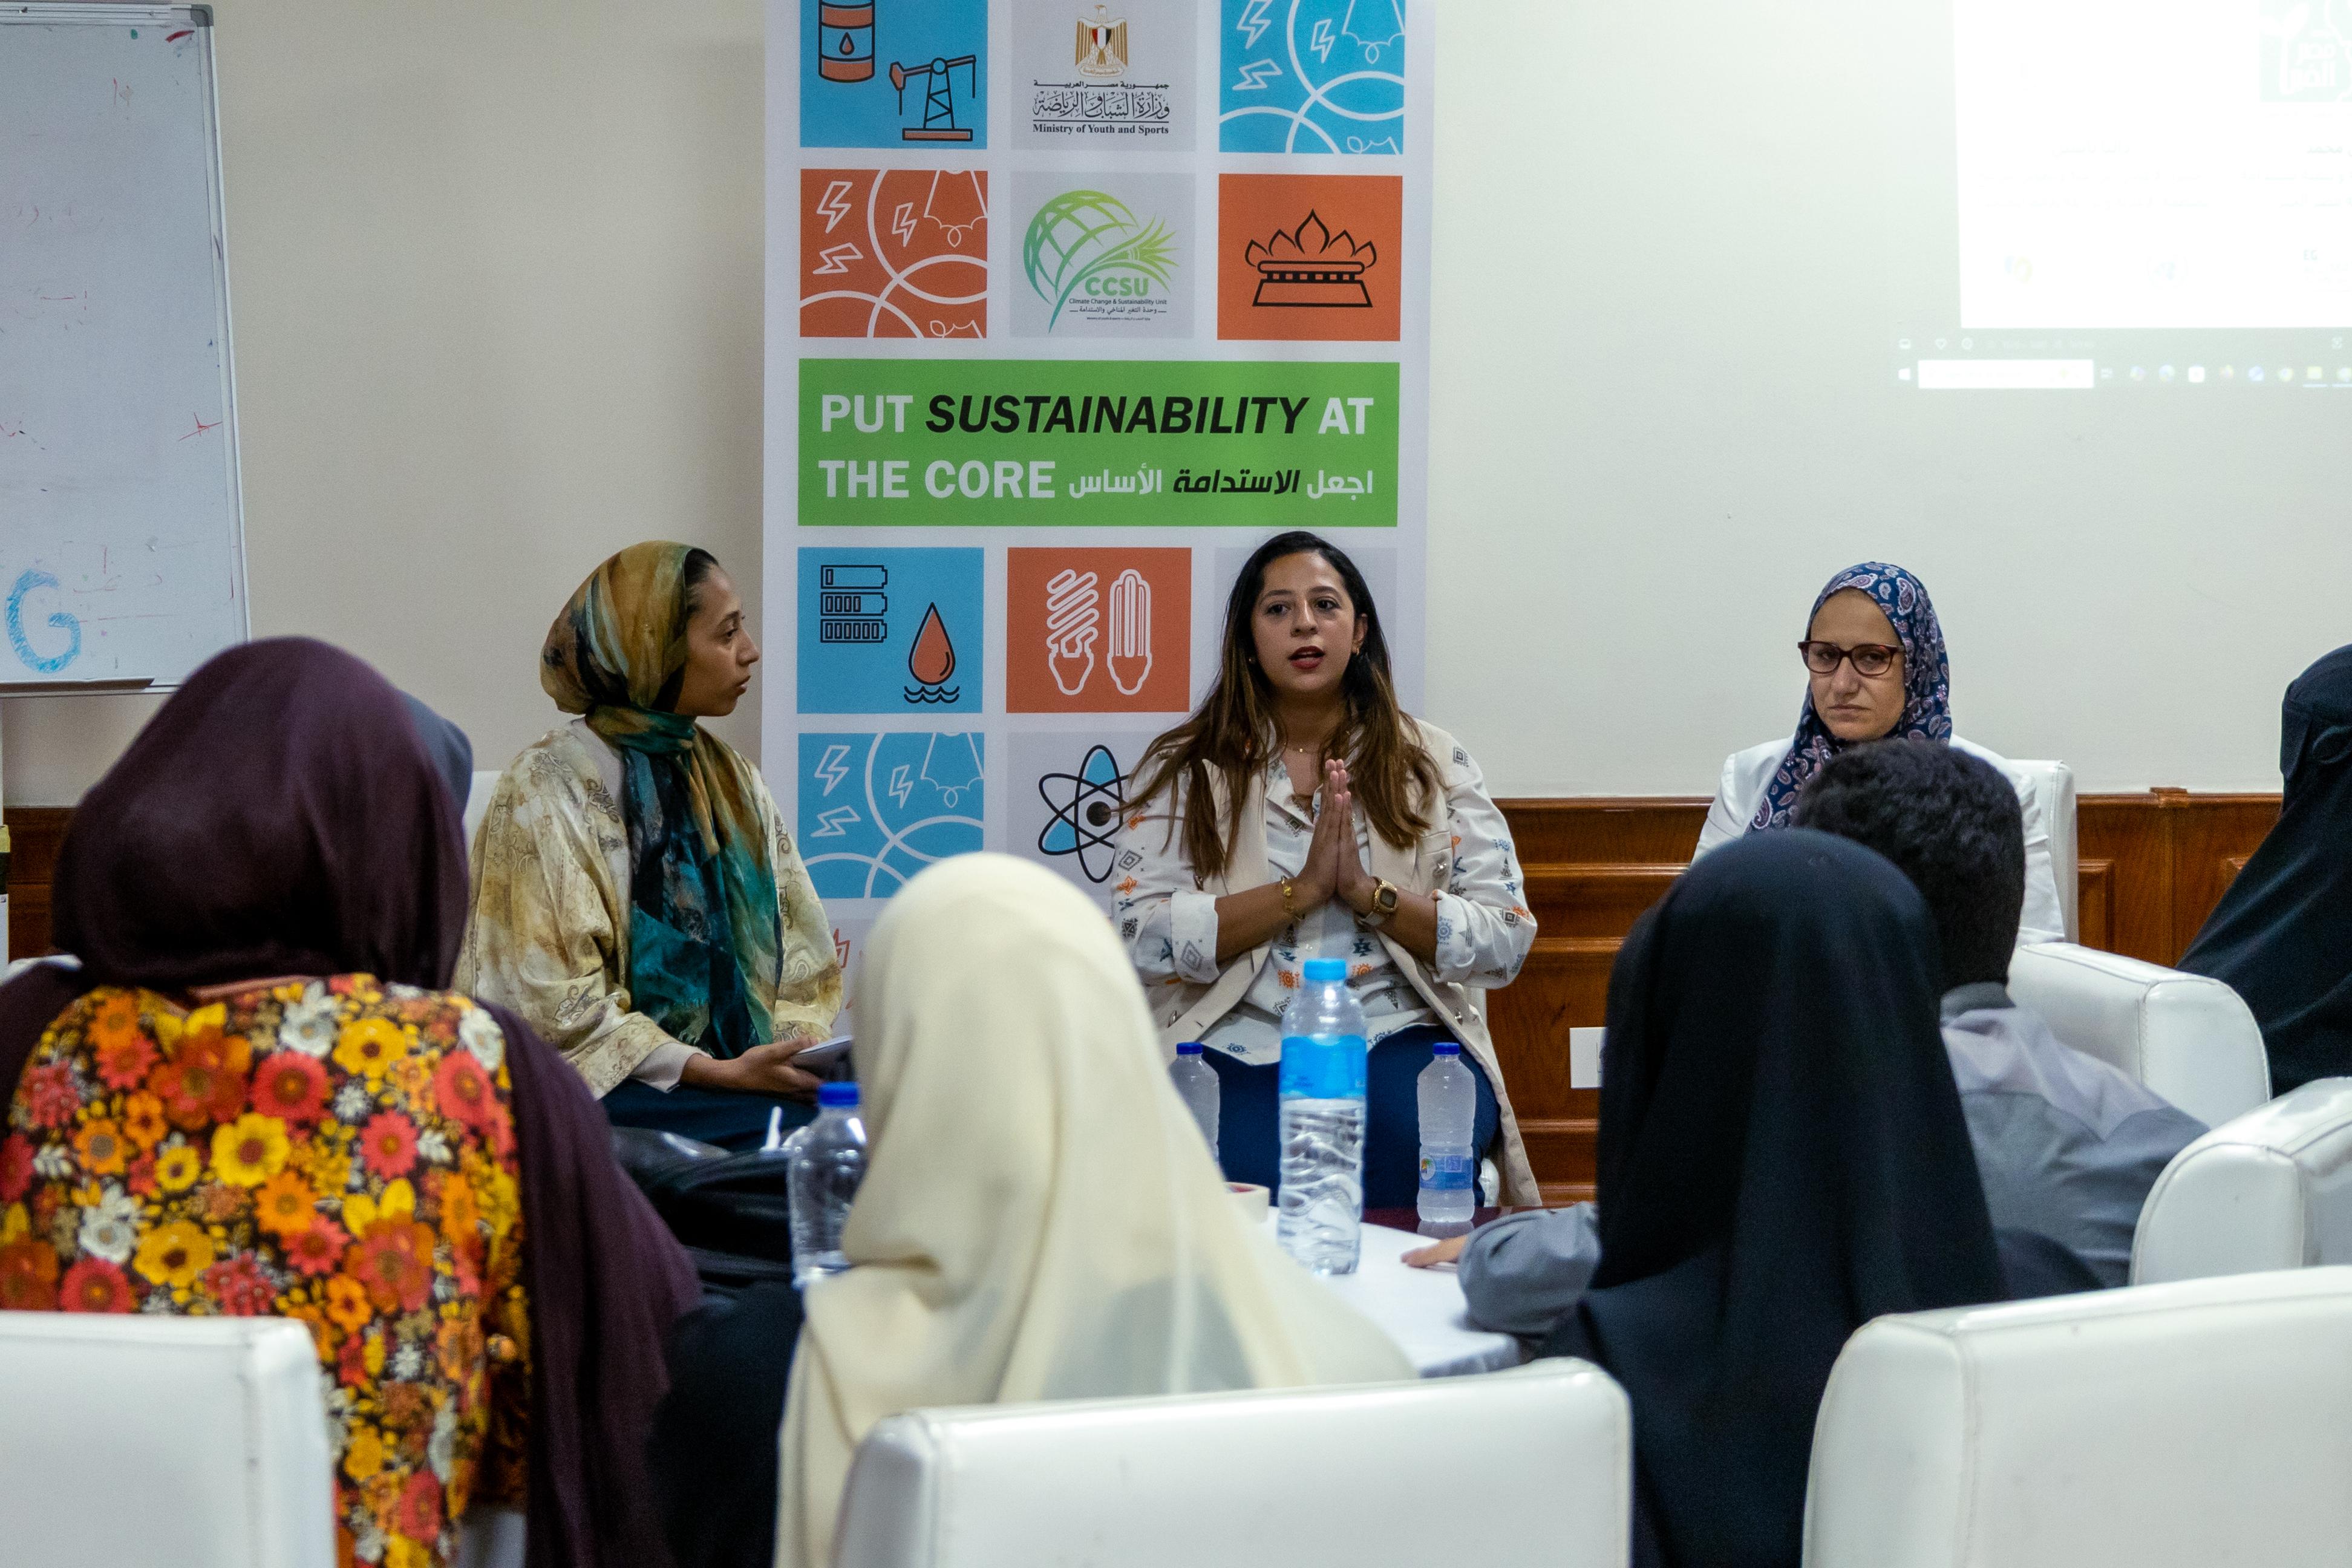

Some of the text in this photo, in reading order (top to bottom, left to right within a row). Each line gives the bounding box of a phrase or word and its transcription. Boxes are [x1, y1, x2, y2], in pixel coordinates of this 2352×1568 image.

[1033, 79, 1084, 88] العربية
[1033, 123, 1169, 136] Ministry of Youth and Sports
[1085, 276, 1149, 296] CCSU
[821, 394, 1374, 434] PUT SUSTAINABILITY AT
[818, 460, 1056, 498] THE CORE
[1068, 463, 1373, 500] اجعل الاستدامة الأساس
[5, 569, 82, 674] G
